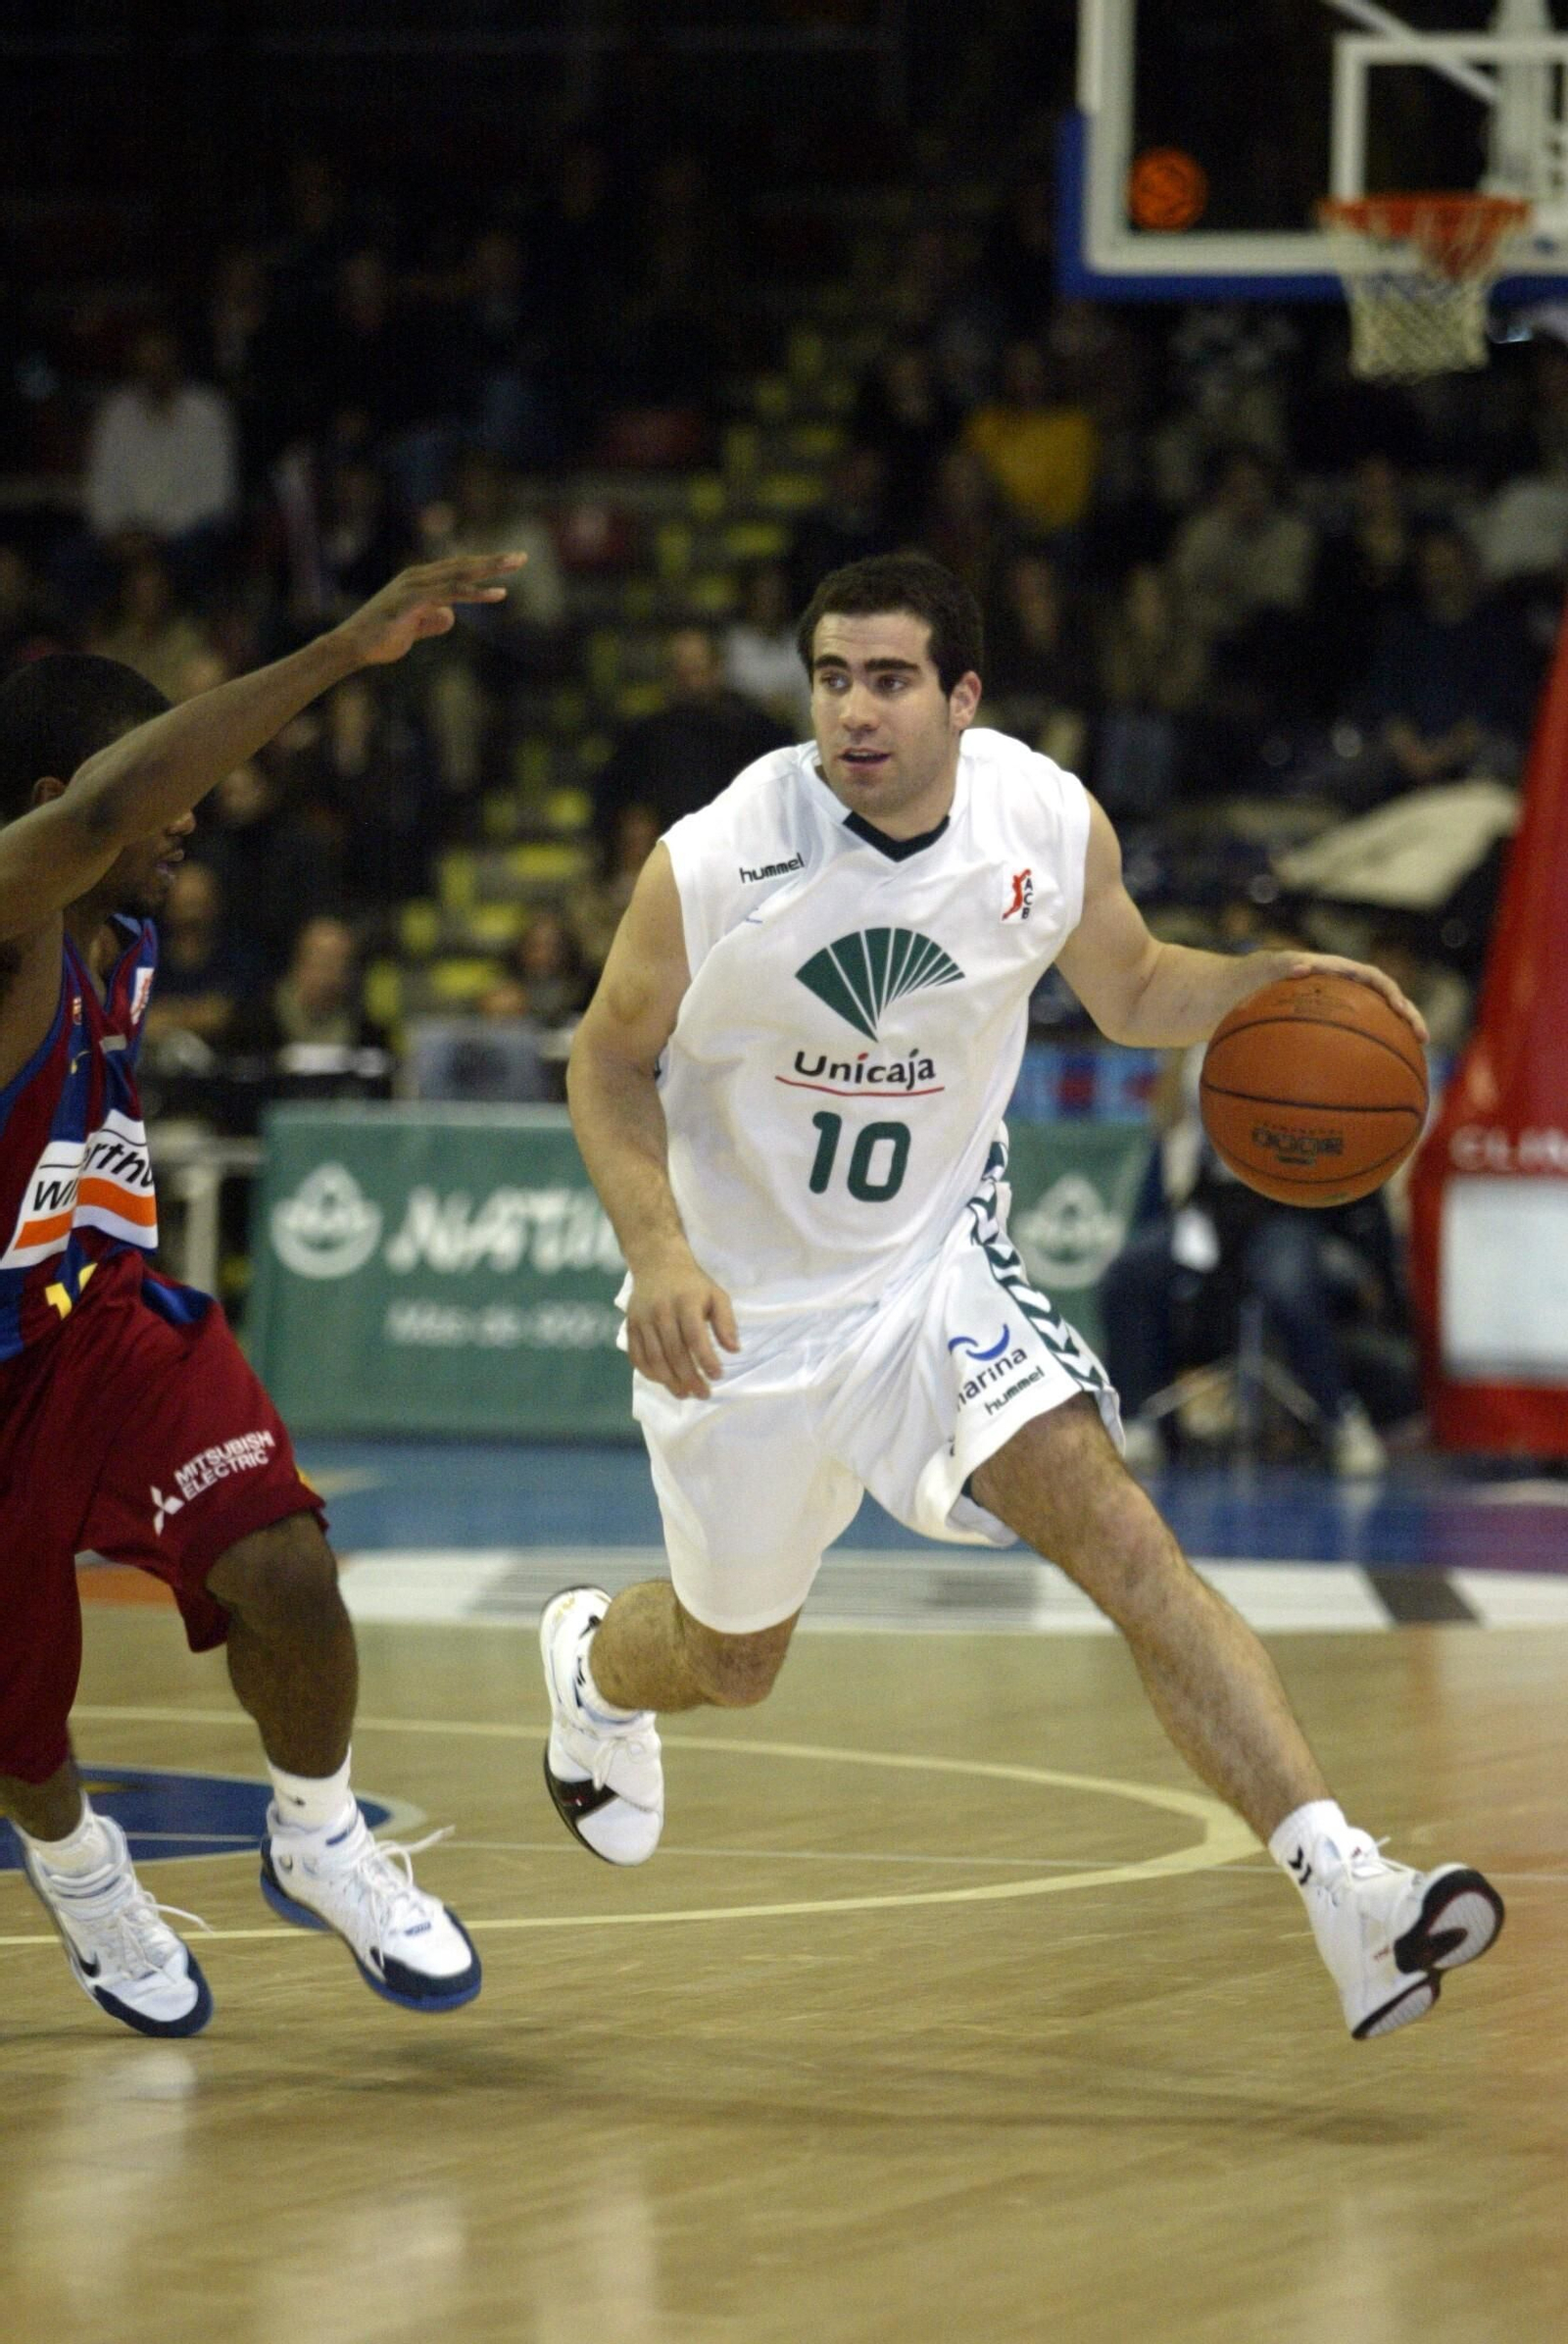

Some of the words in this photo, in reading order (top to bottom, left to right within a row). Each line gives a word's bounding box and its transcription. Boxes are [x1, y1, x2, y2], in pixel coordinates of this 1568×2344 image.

[739, 852, 806, 884] hummel
[1021, 877, 1034, 920] ACB
[794, 1048, 936, 1091] Unicaja
[808, 1110, 911, 1203] 10
[984, 1365, 1046, 1416] hummel
[174, 1430, 275, 1487] MITSUBISHI
[183, 1450, 270, 1501] ELECTRIC
